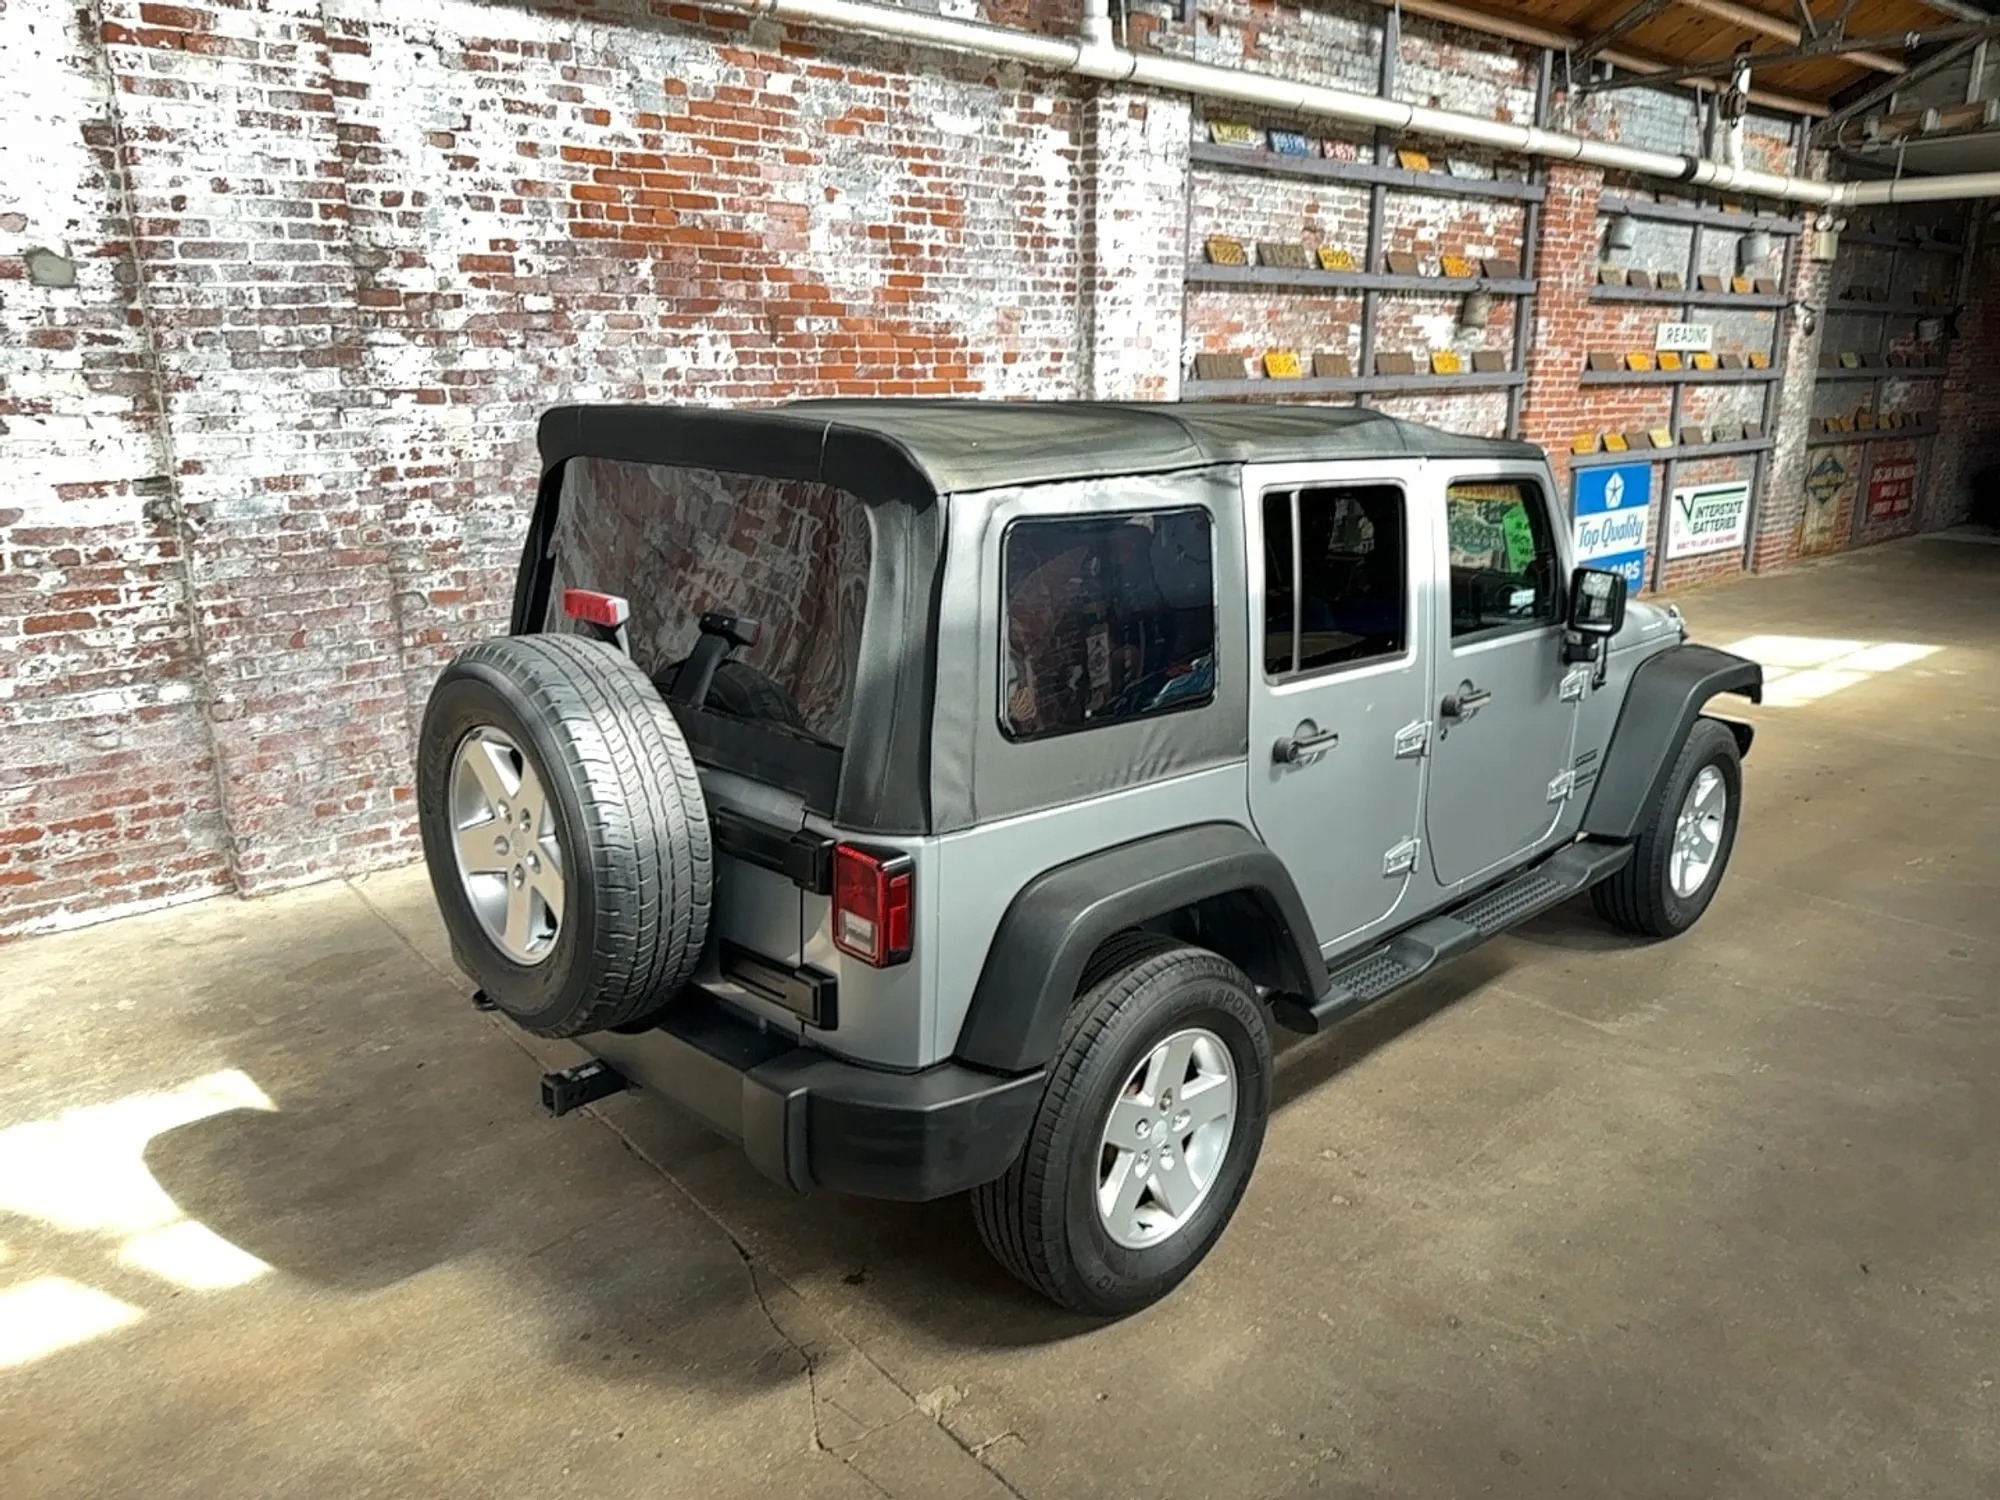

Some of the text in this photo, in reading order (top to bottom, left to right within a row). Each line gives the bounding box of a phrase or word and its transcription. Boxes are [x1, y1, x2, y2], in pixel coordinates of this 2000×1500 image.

[1695, 500, 1744, 519] INTERSTATE
[1579, 521, 1599, 553] Top
[1601, 513, 1643, 547] Quality
[1692, 516, 1737, 535] BATTERIES
